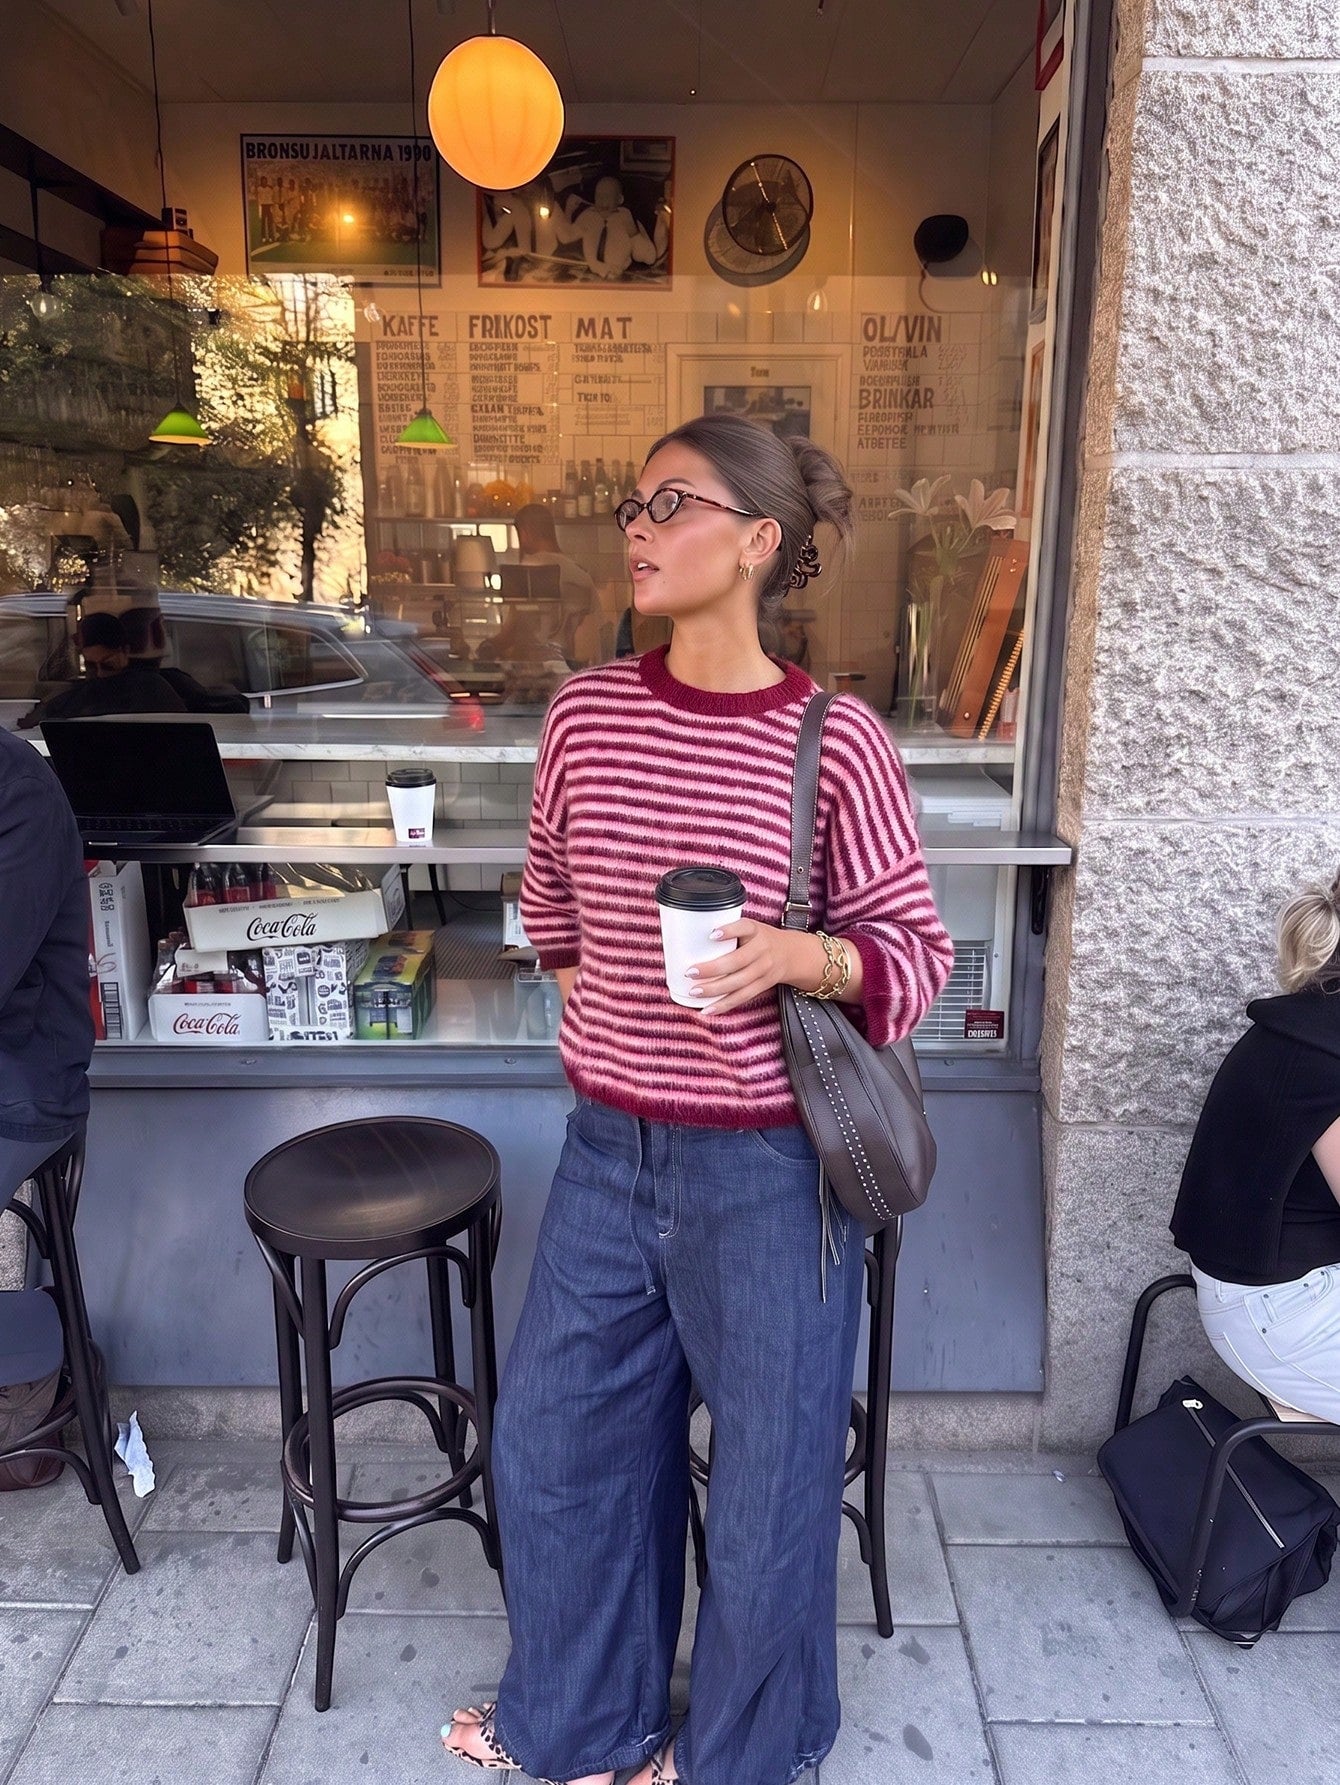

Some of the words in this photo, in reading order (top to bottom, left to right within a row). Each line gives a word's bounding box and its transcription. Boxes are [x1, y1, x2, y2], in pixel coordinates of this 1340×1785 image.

[382, 314, 439, 337] KAFFE
[575, 316, 633, 340] MAT
[858, 387, 934, 410] BRINKAR
[246, 912, 319, 942] Coca-Cola
[172, 1012, 241, 1035] Coca-Cola
